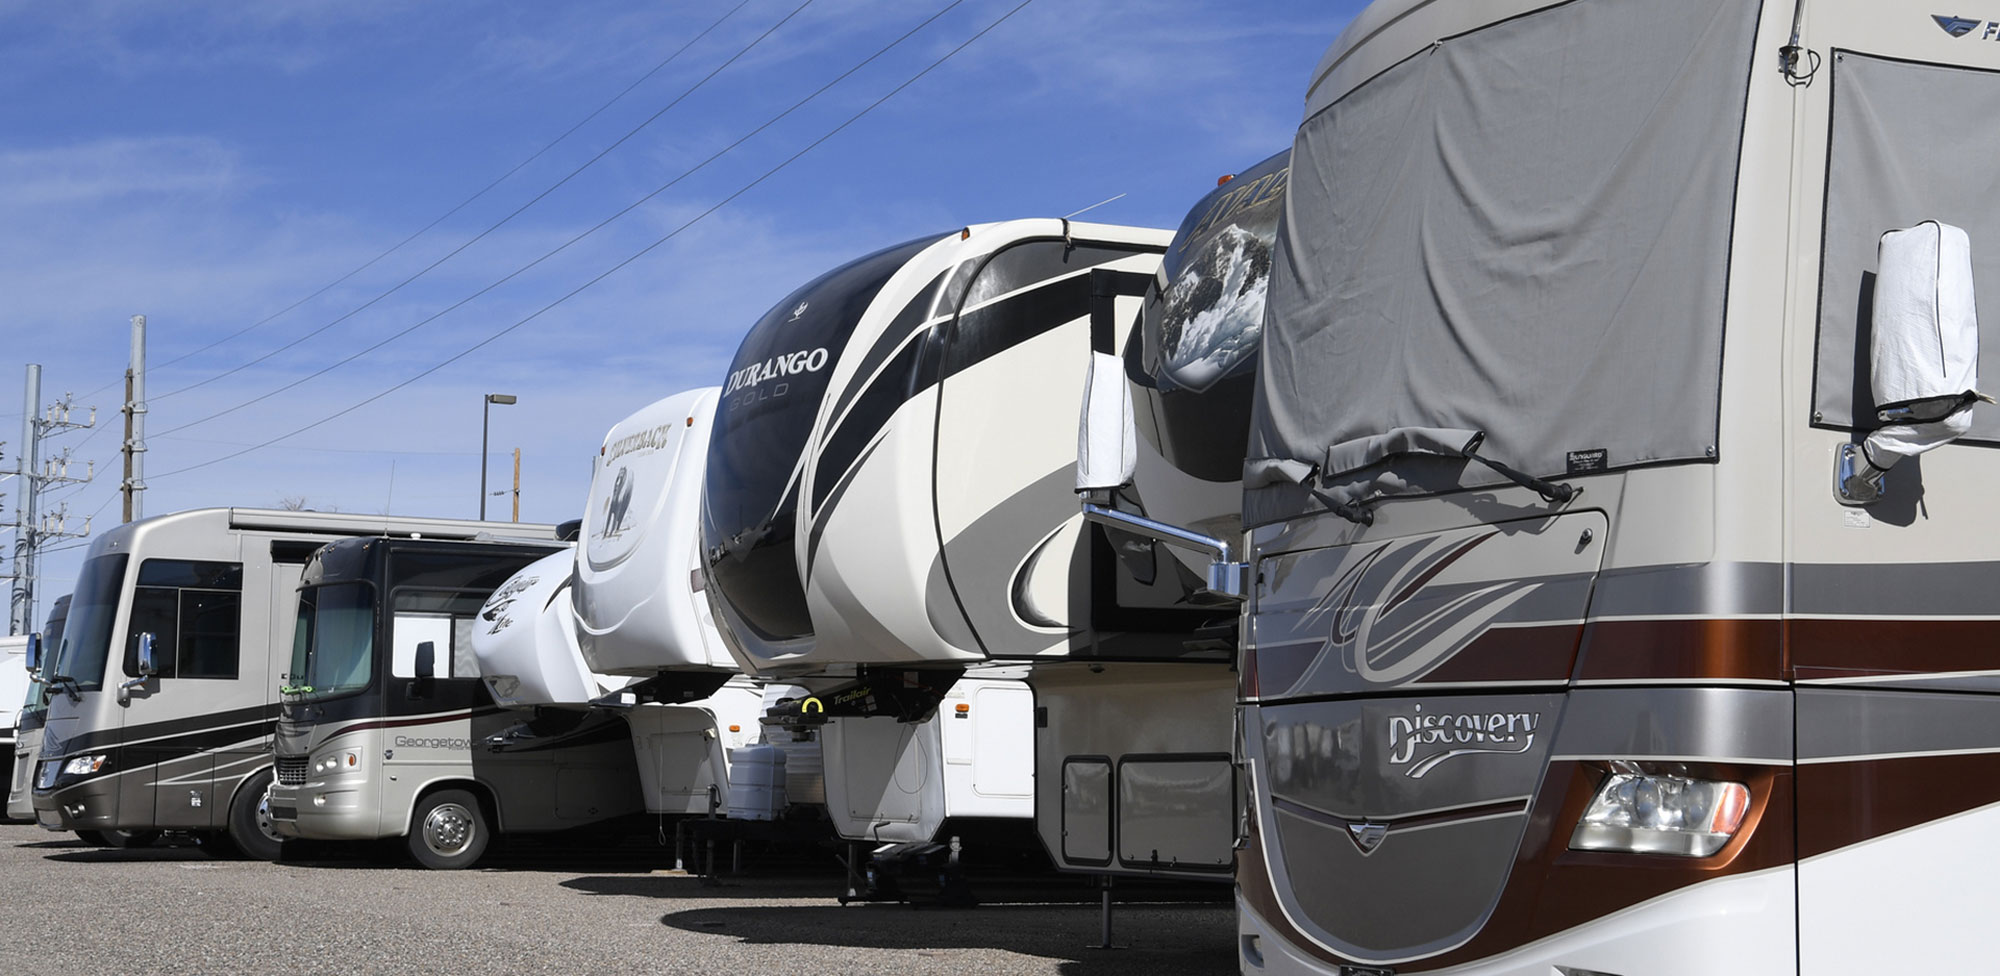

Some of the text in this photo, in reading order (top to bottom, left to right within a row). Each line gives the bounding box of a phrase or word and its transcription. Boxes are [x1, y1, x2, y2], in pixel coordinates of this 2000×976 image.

[723, 347, 829, 398] DURANGO
[729, 382, 789, 412] GOLD
[1388, 702, 1541, 778] Discovery
